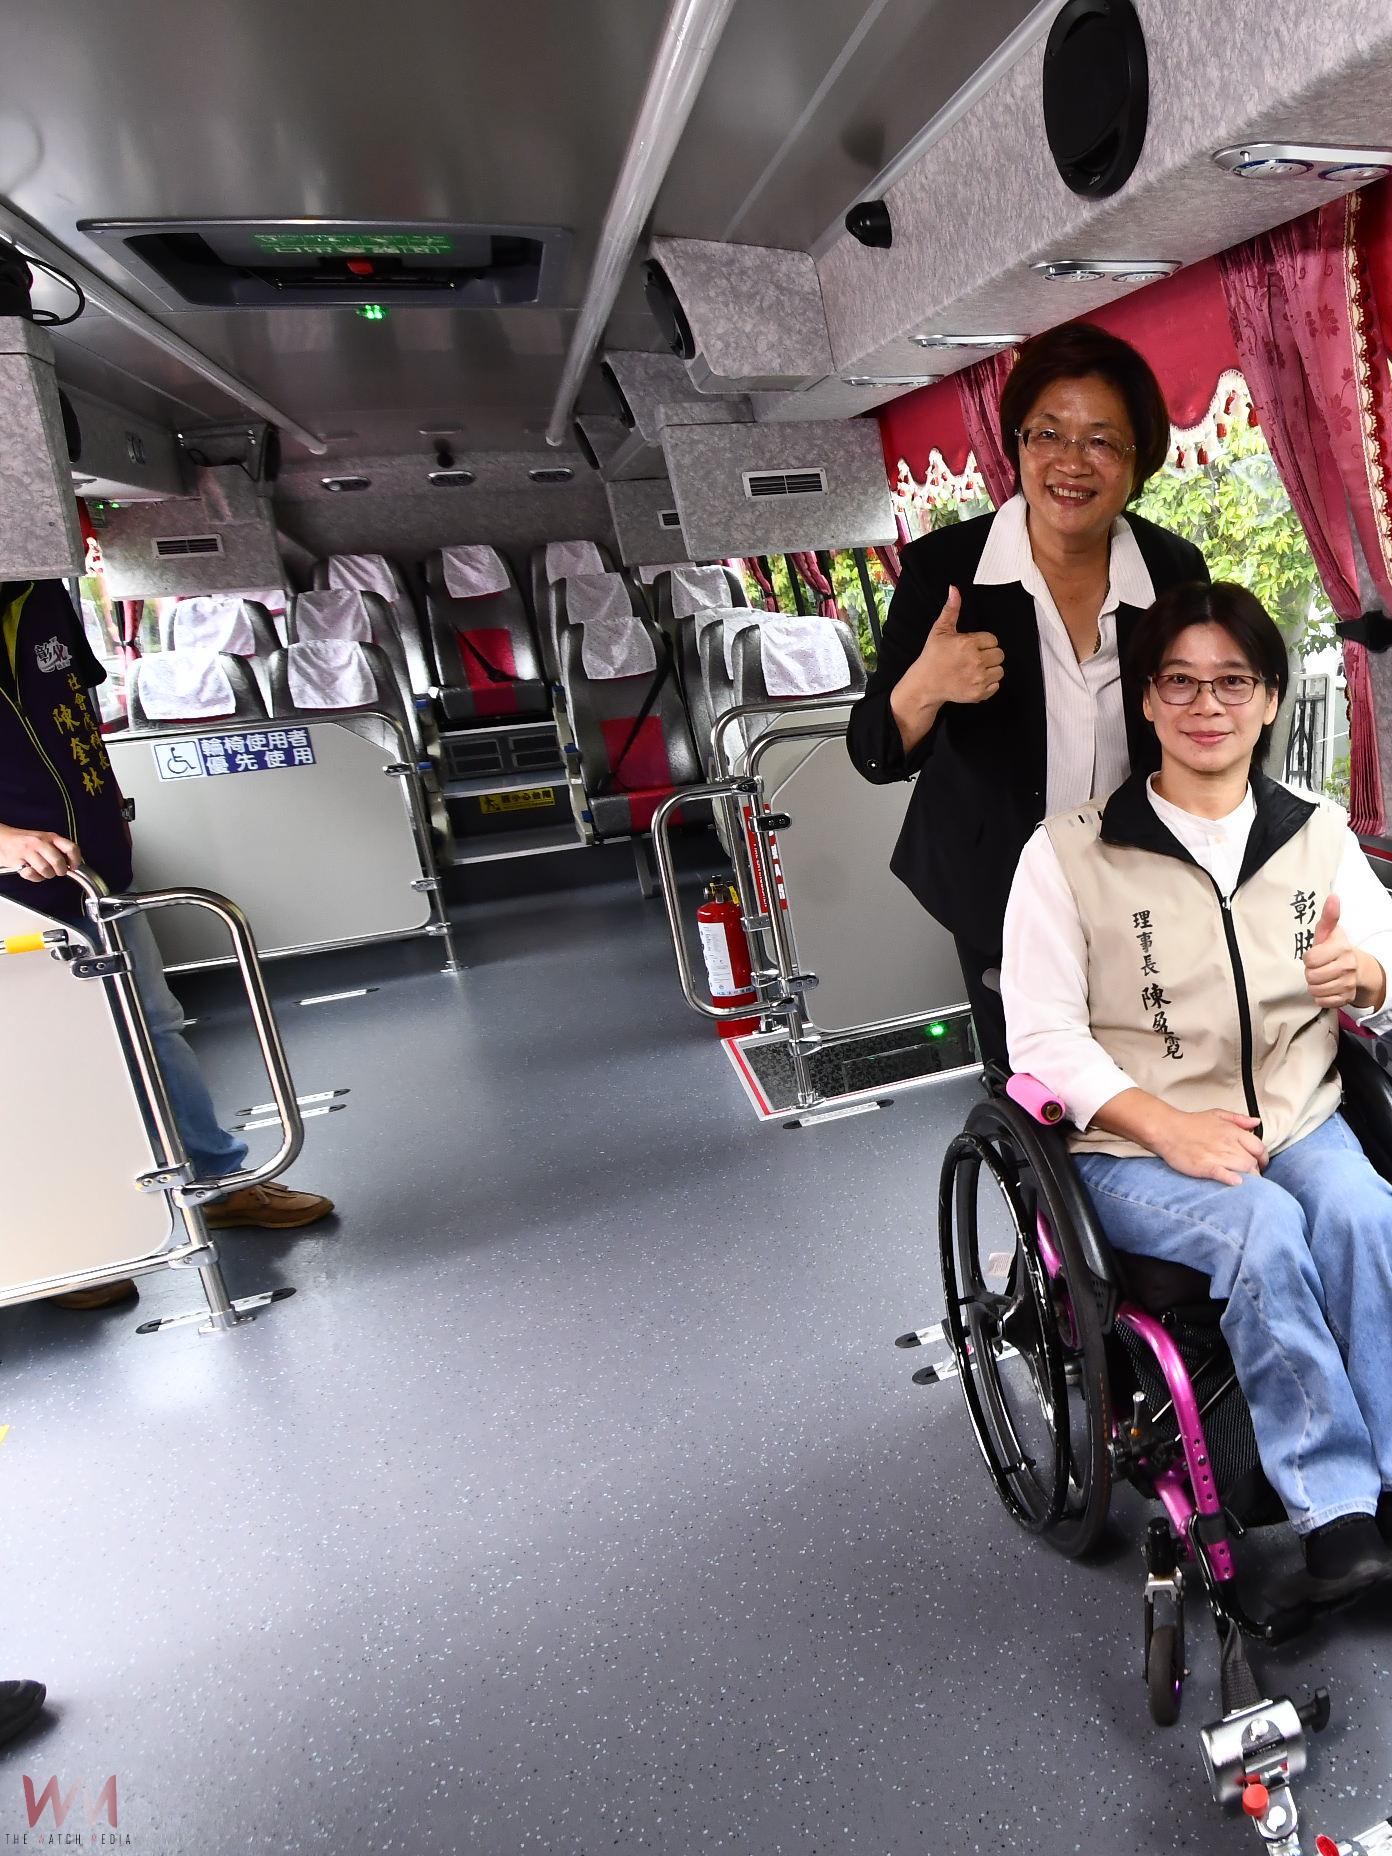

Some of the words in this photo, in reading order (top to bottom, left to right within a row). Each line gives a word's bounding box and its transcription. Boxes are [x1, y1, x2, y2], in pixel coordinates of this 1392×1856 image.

[200, 729, 309, 757] 輪椅使用者
[206, 747, 314, 775] 優先使用
[1132, 909, 1161, 977] 理事長
